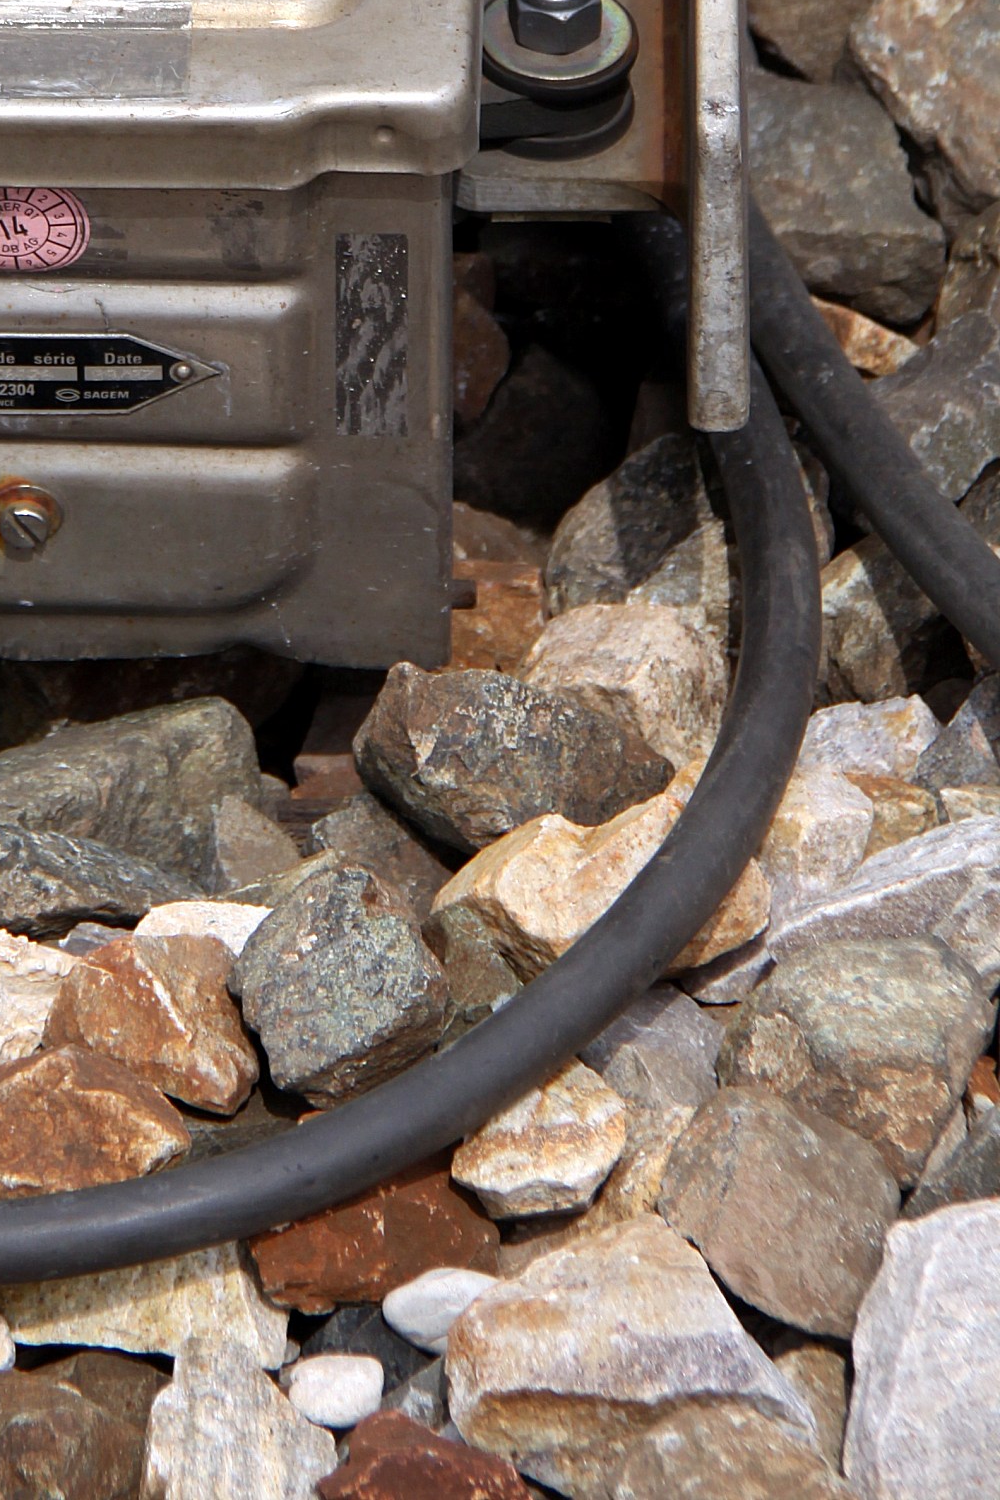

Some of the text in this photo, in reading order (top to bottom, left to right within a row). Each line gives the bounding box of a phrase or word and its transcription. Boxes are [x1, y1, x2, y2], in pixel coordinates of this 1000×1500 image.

[2, 237, 39, 253] DB AG
[33, 353, 76, 365] série
[104, 353, 143, 365] Date
[83, 391, 129, 399] SAGEM
